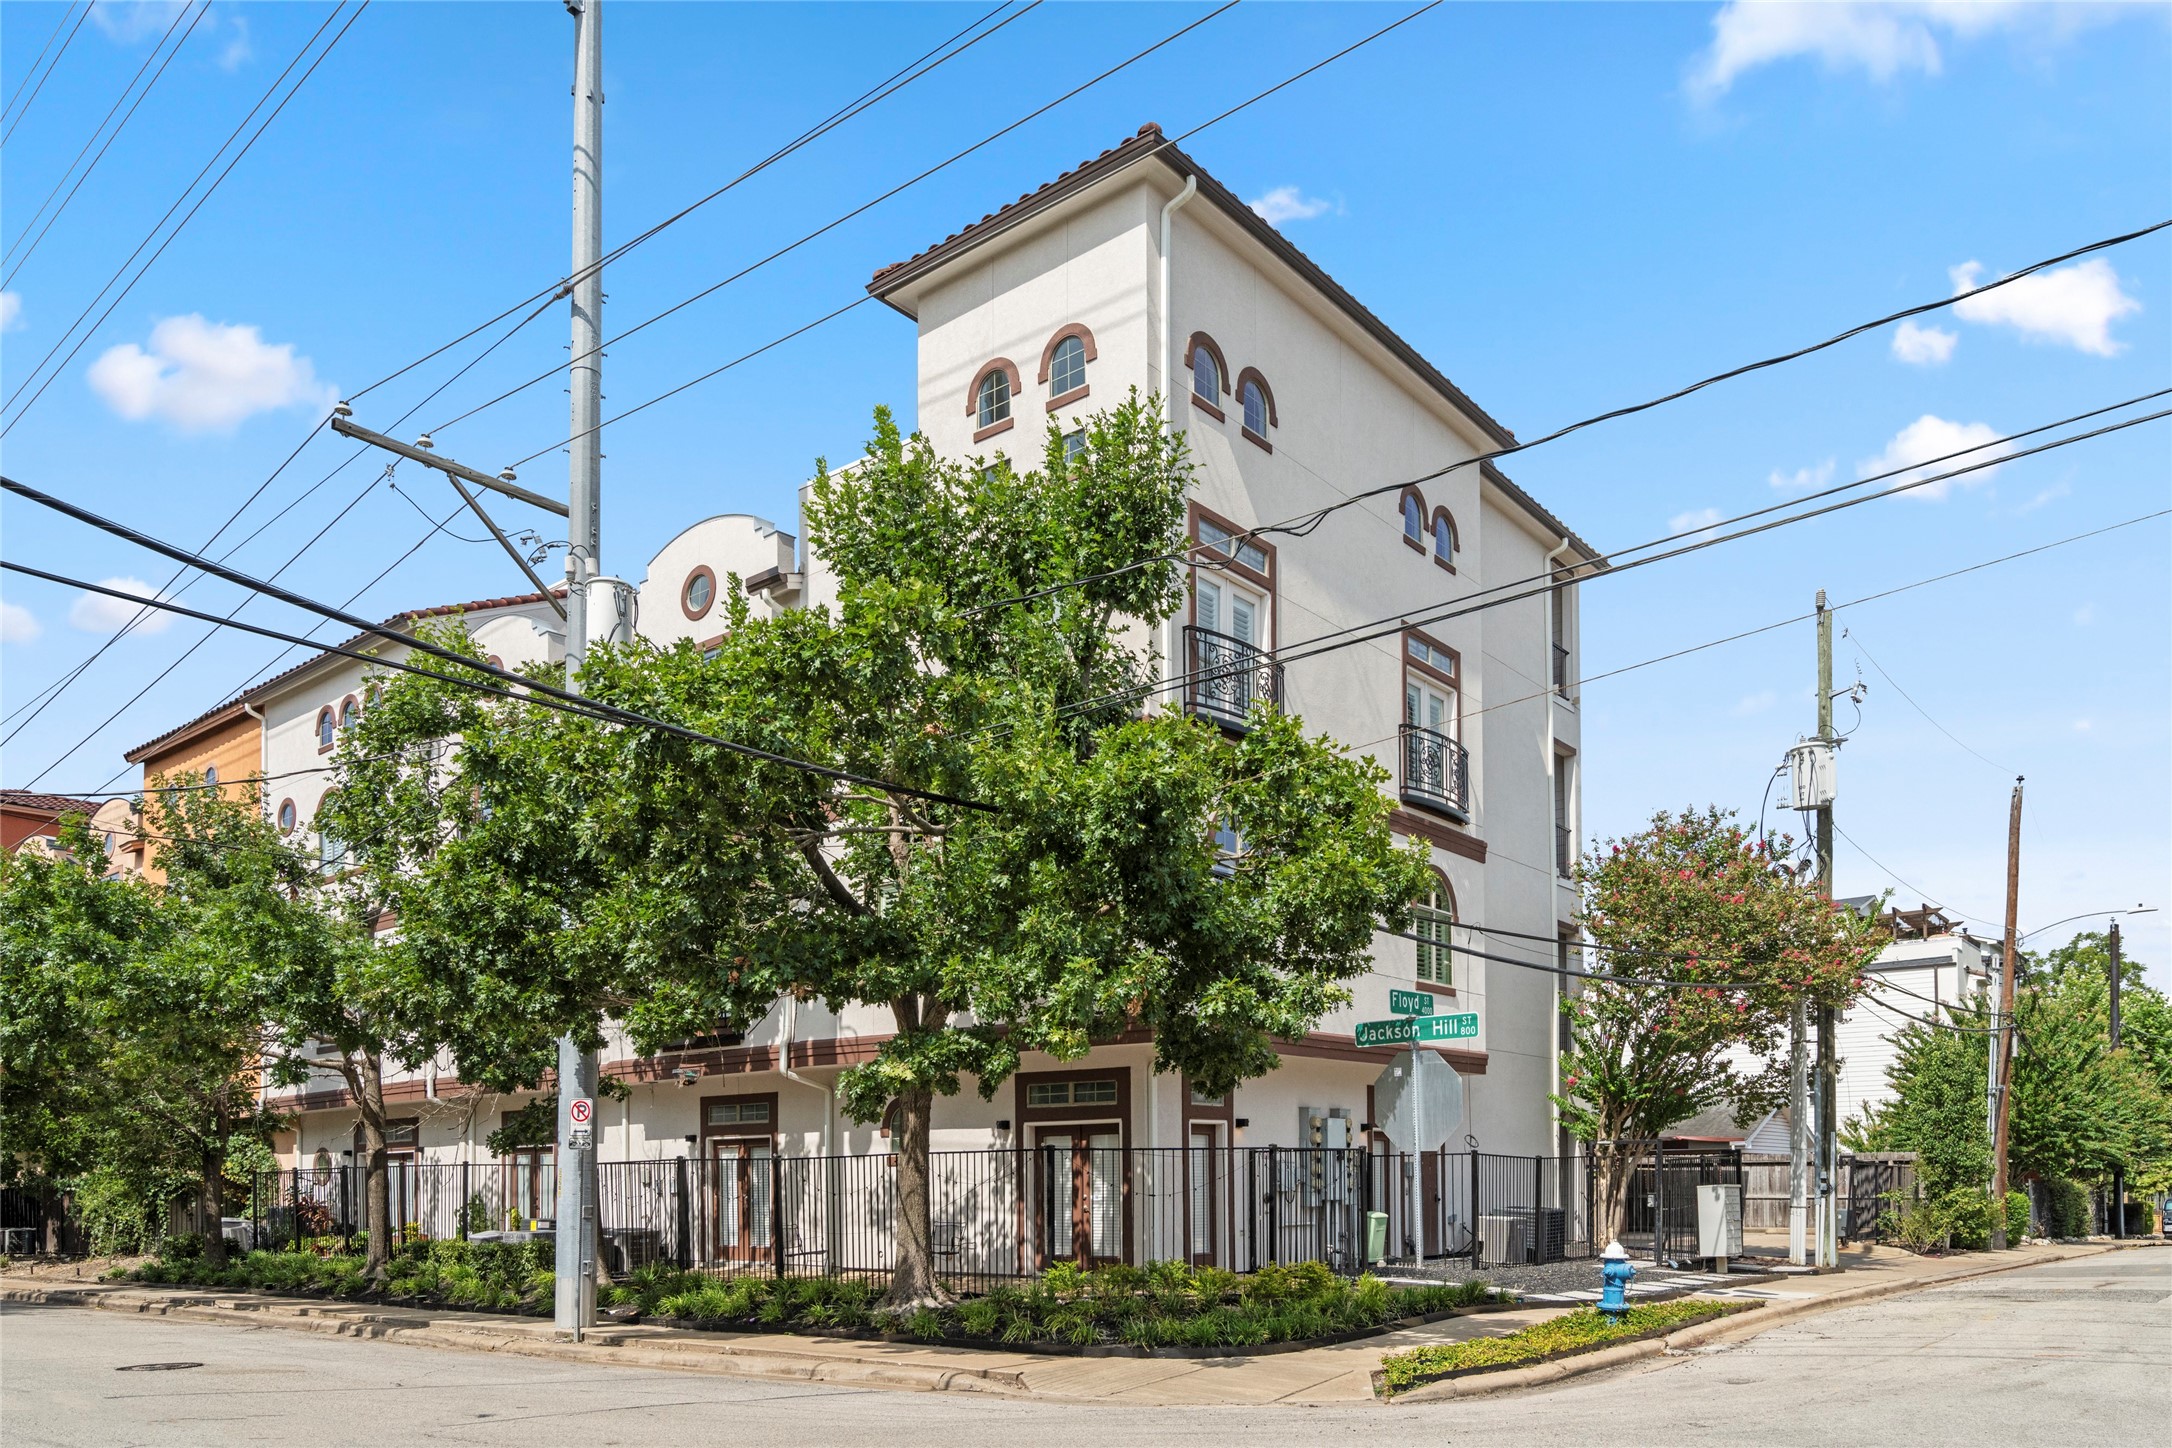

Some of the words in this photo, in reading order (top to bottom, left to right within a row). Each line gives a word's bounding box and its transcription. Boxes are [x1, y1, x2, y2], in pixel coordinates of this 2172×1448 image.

[1392, 992, 1419, 1012] Floyd
[1423, 996, 1430, 1005] ST
[1421, 1006, 1433, 1015] 4000
[1359, 1024, 1420, 1042] Jackson
[1432, 1019, 1458, 1035] Hill
[1462, 1016, 1472, 1025] ST
[1460, 1026, 1476, 1035] 800
